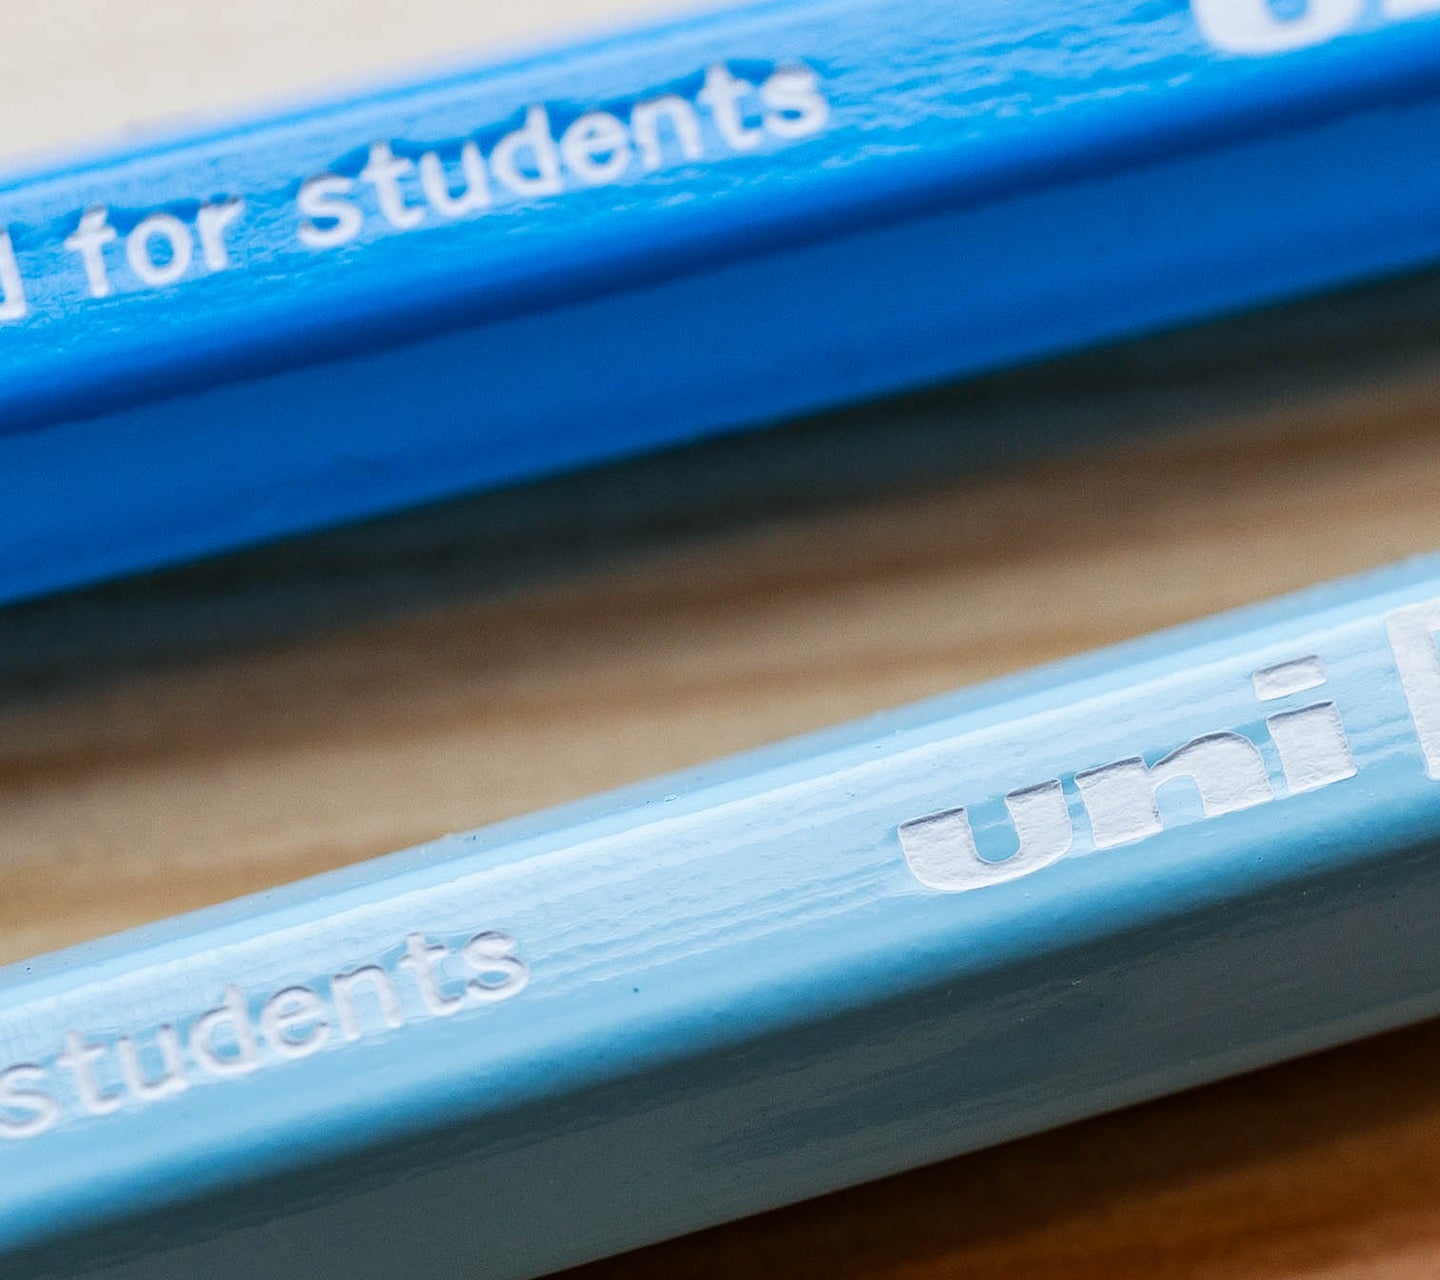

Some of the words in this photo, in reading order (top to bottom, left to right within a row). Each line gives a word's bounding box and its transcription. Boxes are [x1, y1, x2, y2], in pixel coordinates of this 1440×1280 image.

[63, 194, 242, 298] for
[296, 63, 831, 248] students
[898, 654, 1358, 894] uni
[0, 927, 530, 1139] students
